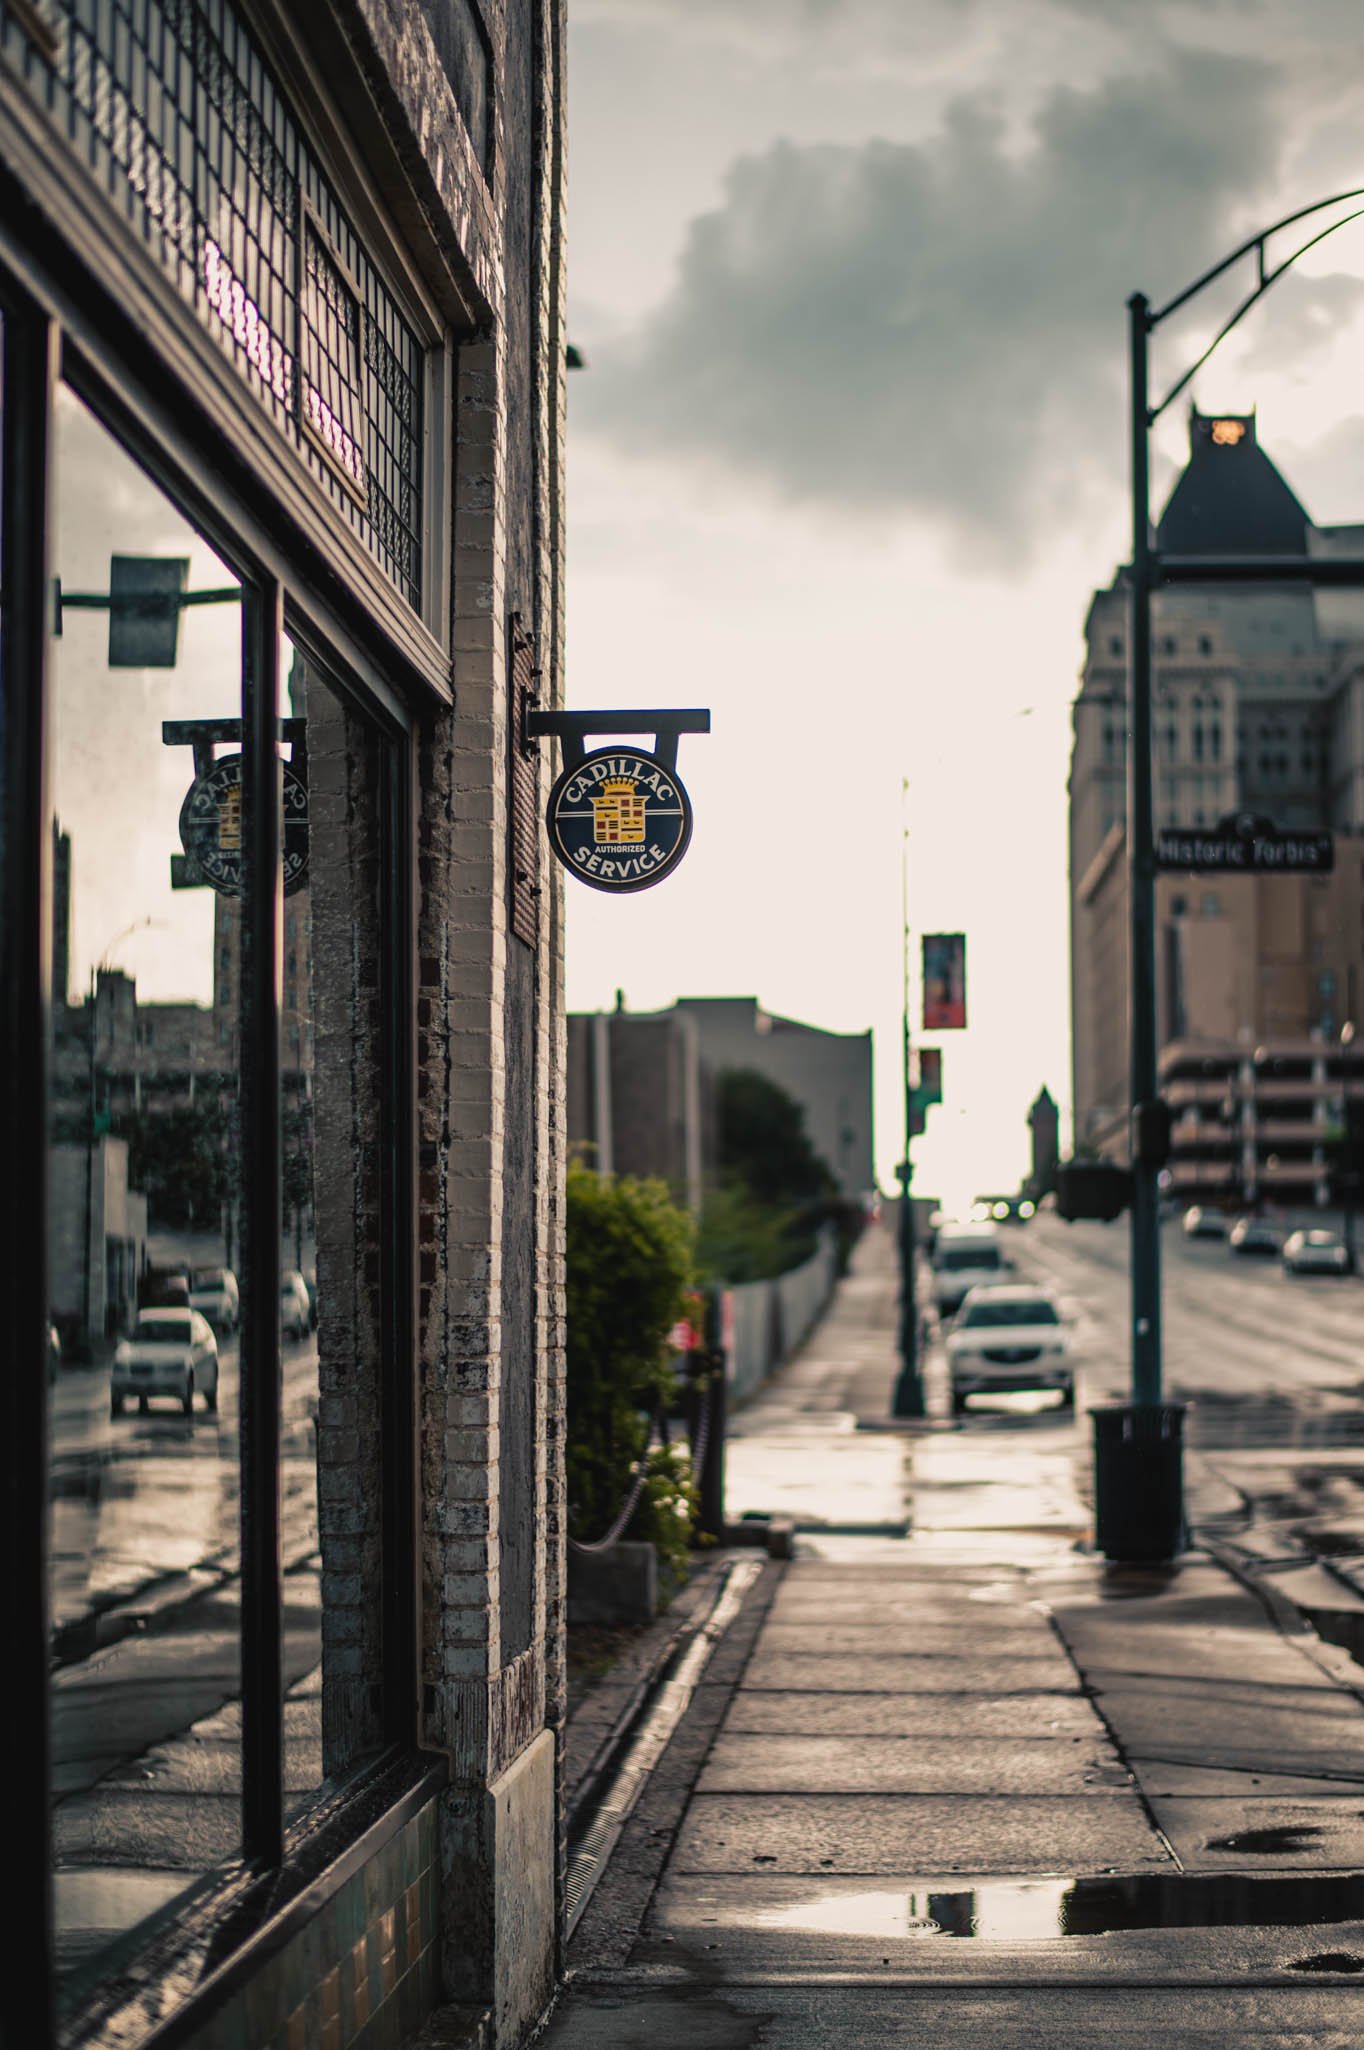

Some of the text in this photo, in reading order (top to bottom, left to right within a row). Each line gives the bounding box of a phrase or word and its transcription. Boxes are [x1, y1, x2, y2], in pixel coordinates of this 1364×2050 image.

[565, 759, 674, 804] CADILLAC
[573, 843, 666, 878] SERVICE
[594, 844, 646, 854] AUTHORIZED
[1158, 839, 1244, 862] Historic
